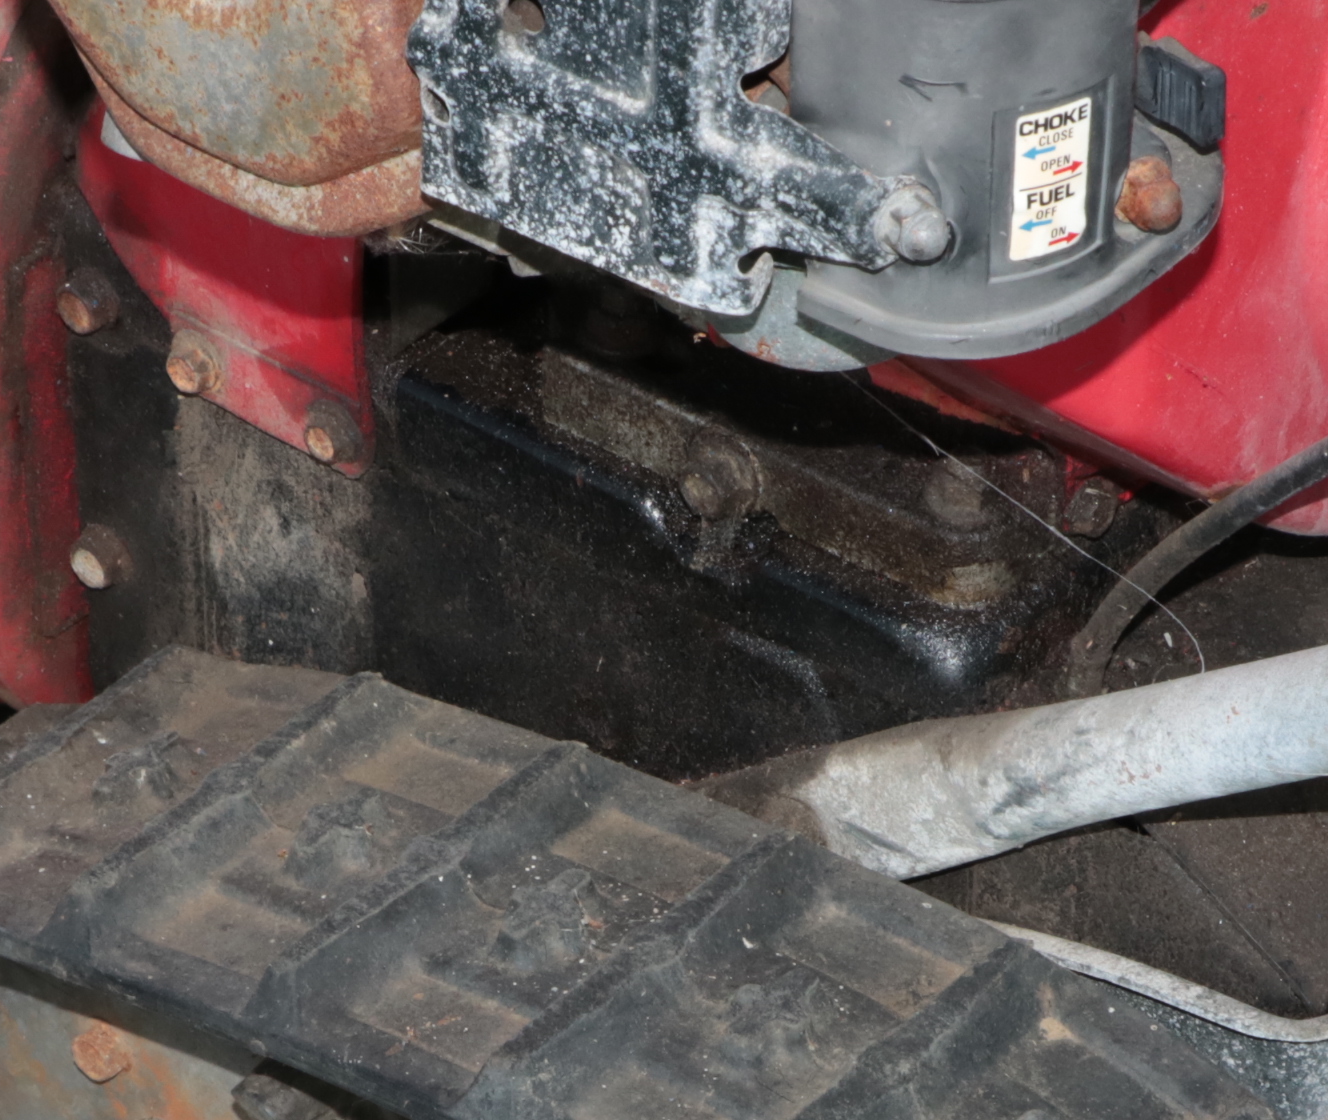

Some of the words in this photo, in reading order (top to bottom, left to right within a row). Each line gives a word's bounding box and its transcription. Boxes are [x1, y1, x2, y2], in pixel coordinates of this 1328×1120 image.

[1019, 103, 1088, 137] CHOKE
[1039, 128, 1074, 147] CLOSE
[1041, 154, 1071, 172] OPEN
[1027, 183, 1075, 210] FUEL
[1036, 206, 1057, 220] OFF
[1051, 226, 1066, 239] ON
